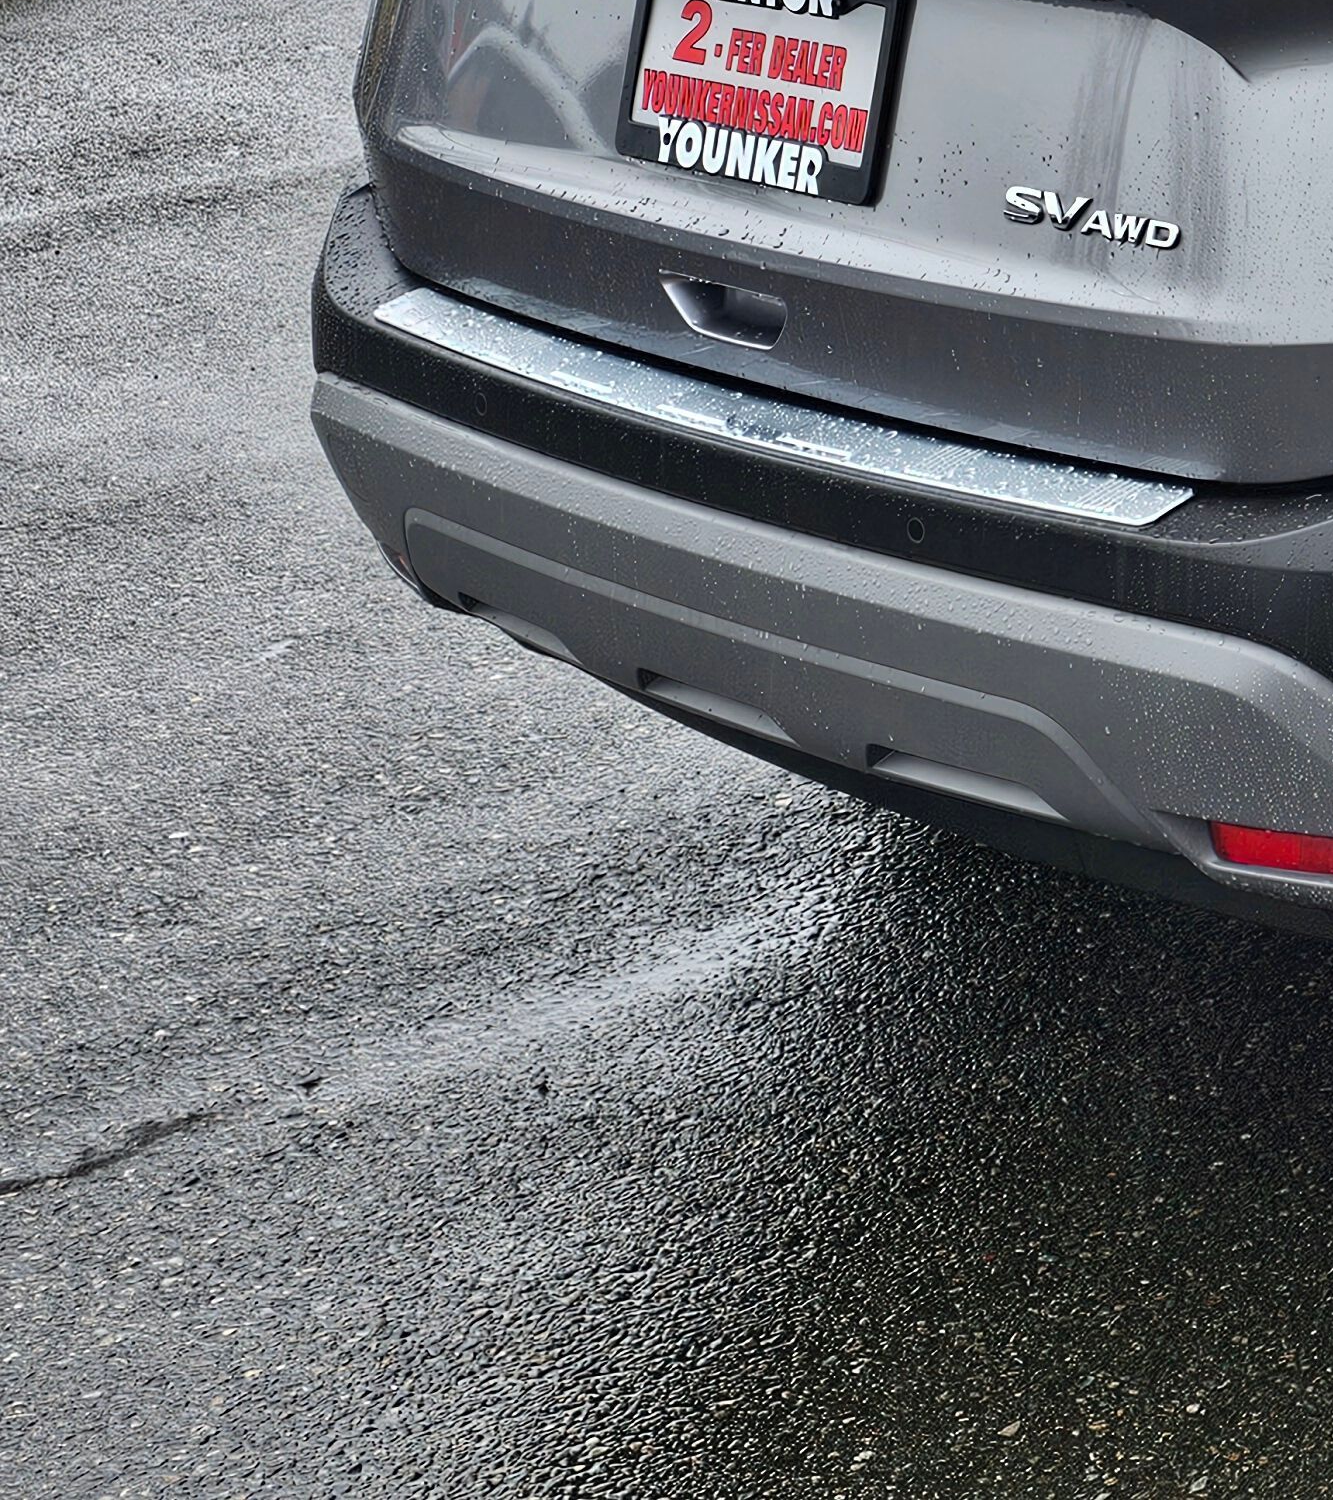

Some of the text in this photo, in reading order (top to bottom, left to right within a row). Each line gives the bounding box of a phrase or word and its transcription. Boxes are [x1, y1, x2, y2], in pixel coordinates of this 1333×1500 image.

[725, 27, 767, 77] FER
[768, 35, 848, 92] DEALER
[641, 68, 868, 154] YOUNKERNISSAN.COM
[657, 115, 824, 196] YOUNKER
[1003, 185, 1182, 250] SV AWD
